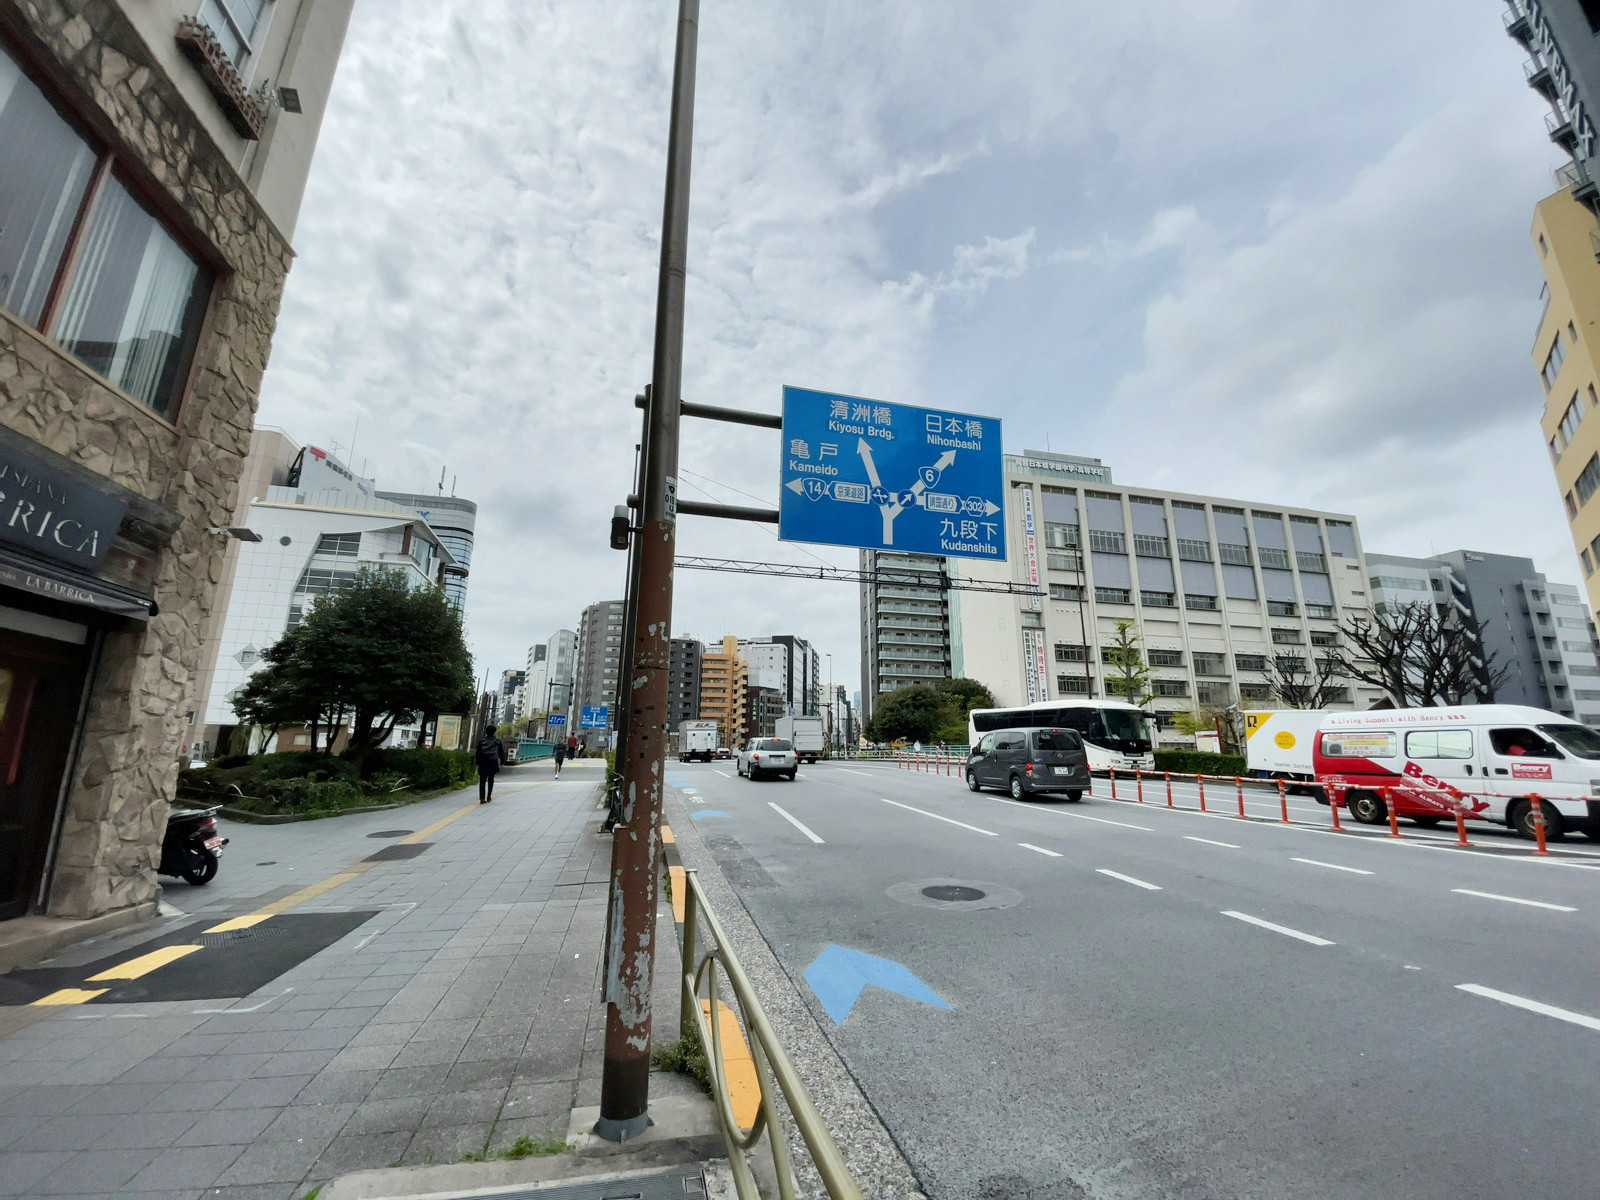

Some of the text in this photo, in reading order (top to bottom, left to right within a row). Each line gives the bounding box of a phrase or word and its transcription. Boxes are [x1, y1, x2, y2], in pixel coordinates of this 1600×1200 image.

[829, 399, 892, 426] 清洲橋
[828, 419, 895, 440] Kiyosu Brdg.
[926, 413, 983, 439] 日本橋
[790, 439, 839, 461] 亀戸
[927, 433, 982, 451] Nihonbashi
[789, 459, 839, 476] Kameido
[925, 469, 935, 483] 6
[808, 480, 822, 495] 14
[967, 500, 983, 512] 302
[940, 518, 998, 541] 九段下
[941, 538, 998, 555] Kudanshita
[25, 575, 40, 588] LA
[44, 580, 95, 603] BARRICA
[1420, 714, 1444, 722] Benry
[1512, 764, 1549, 773] Benry
[1418, 794, 1444, 809] ALWAYS
